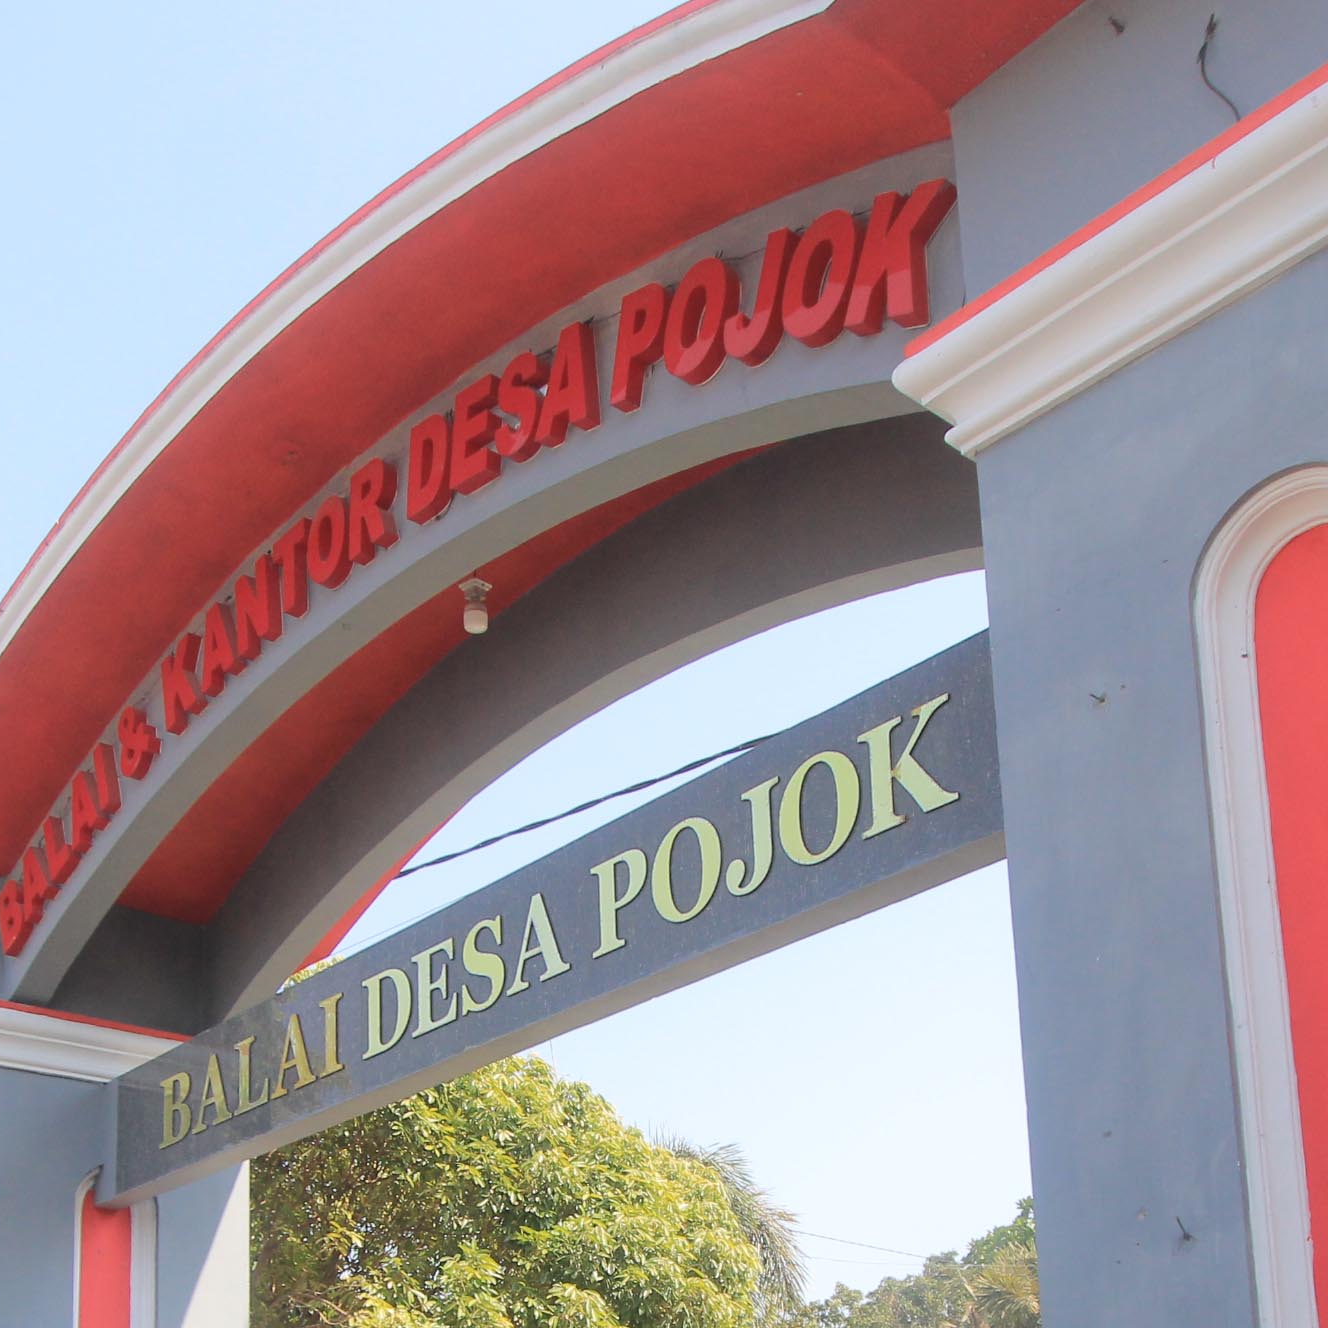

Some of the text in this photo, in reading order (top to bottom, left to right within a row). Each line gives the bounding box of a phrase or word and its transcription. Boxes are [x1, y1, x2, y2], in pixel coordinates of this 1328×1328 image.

[117, 704, 162, 783] &
[160, 446, 400, 737] KANTOR
[407, 320, 601, 526] DESA
[610, 177, 958, 414] POJOK
[158, 691, 961, 1151] BALAI DESA POJOK
